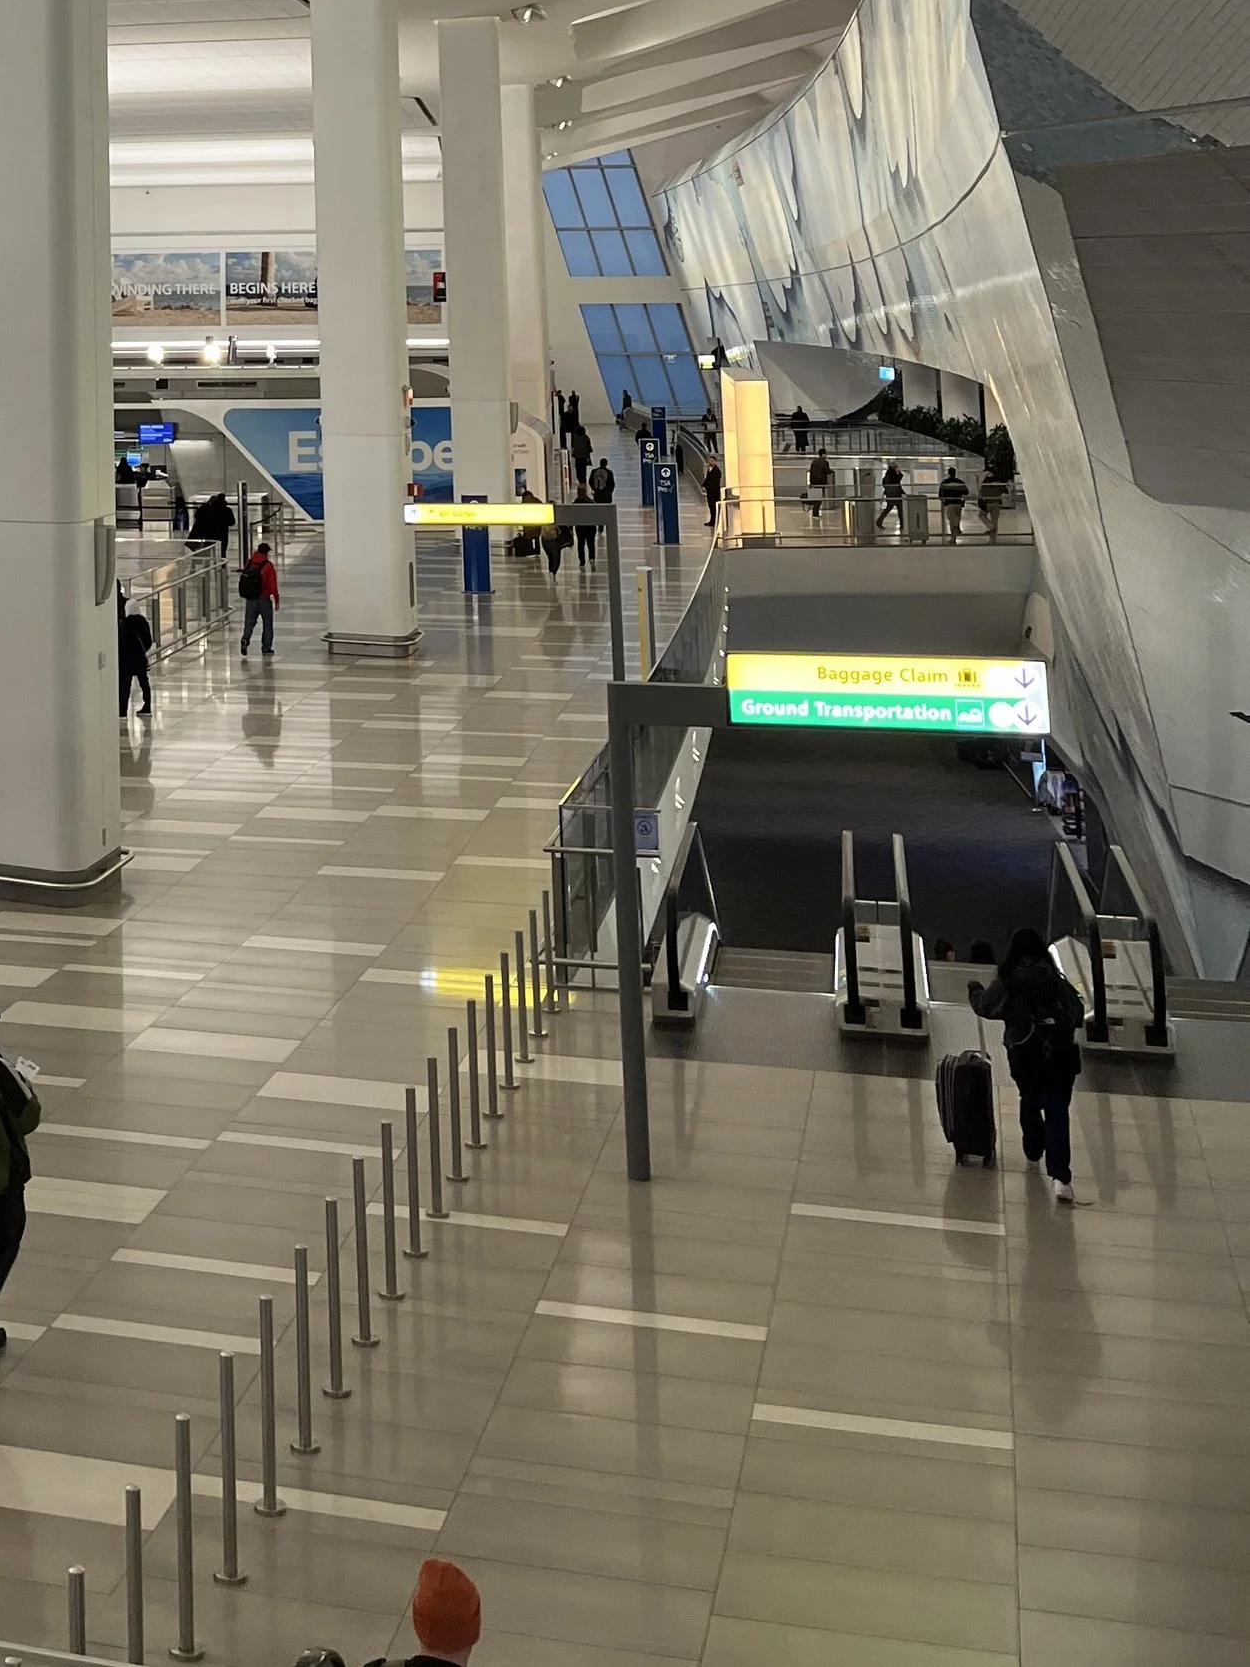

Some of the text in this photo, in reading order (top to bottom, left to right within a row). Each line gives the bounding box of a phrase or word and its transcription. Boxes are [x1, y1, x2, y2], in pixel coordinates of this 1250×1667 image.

[175, 283, 217, 294] THERE
[230, 282, 278, 294] BEGINS
[281, 282, 316, 294] HERE
[817, 666, 949, 684] Baggage Claim
[741, 699, 952, 722] Ground Transportation
